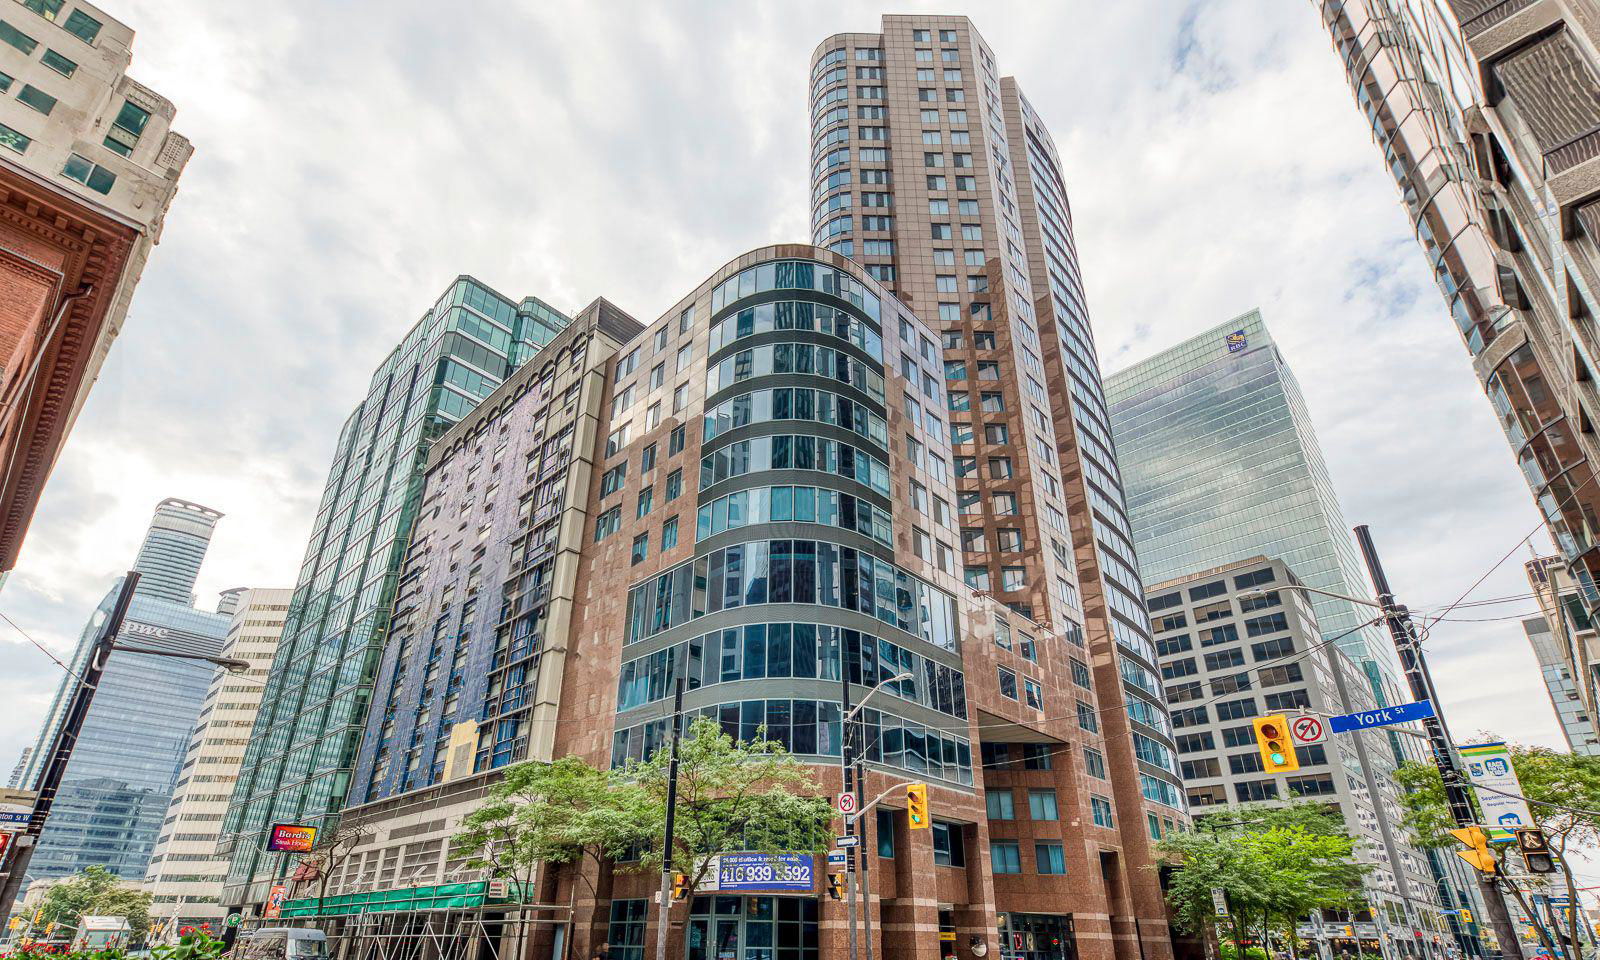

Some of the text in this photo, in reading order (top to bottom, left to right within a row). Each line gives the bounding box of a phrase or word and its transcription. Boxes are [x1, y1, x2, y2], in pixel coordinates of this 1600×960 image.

[1230, 342, 1246, 351] RBC
[1355, 710, 1392, 725] York
[721, 867, 744, 882] 416
[746, 866, 772, 881] 939
